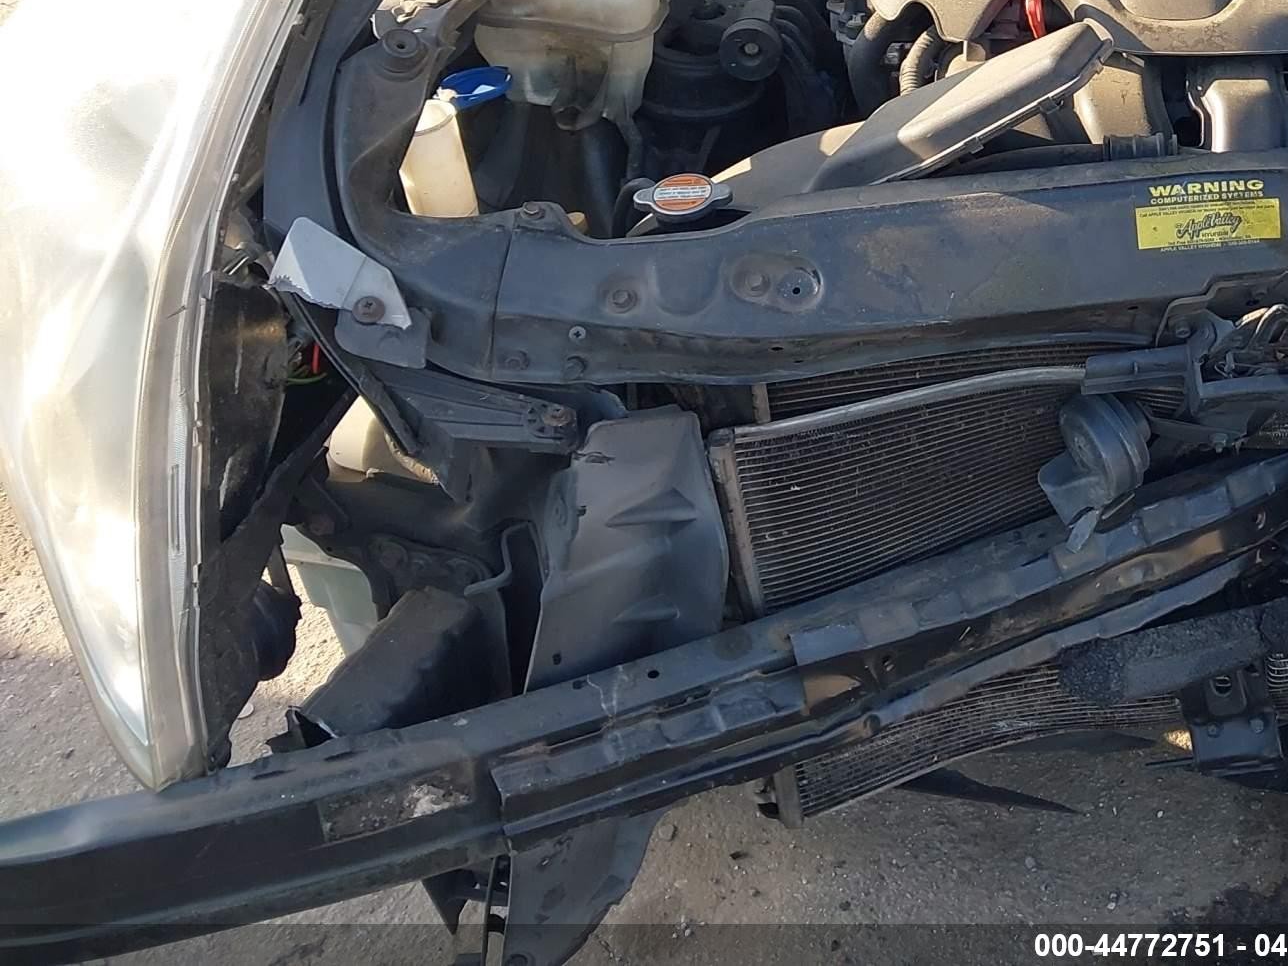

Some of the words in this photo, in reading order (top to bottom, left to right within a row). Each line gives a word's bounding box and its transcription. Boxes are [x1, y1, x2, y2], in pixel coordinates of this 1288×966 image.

[1149, 179, 1264, 197] WARNING
[1150, 192, 1220, 205] COMPUTERIZED
[1221, 190, 1264, 200] SYSTEMS
[1176, 213, 1211, 240] Apple
[1210, 212, 1242, 233] Valley
